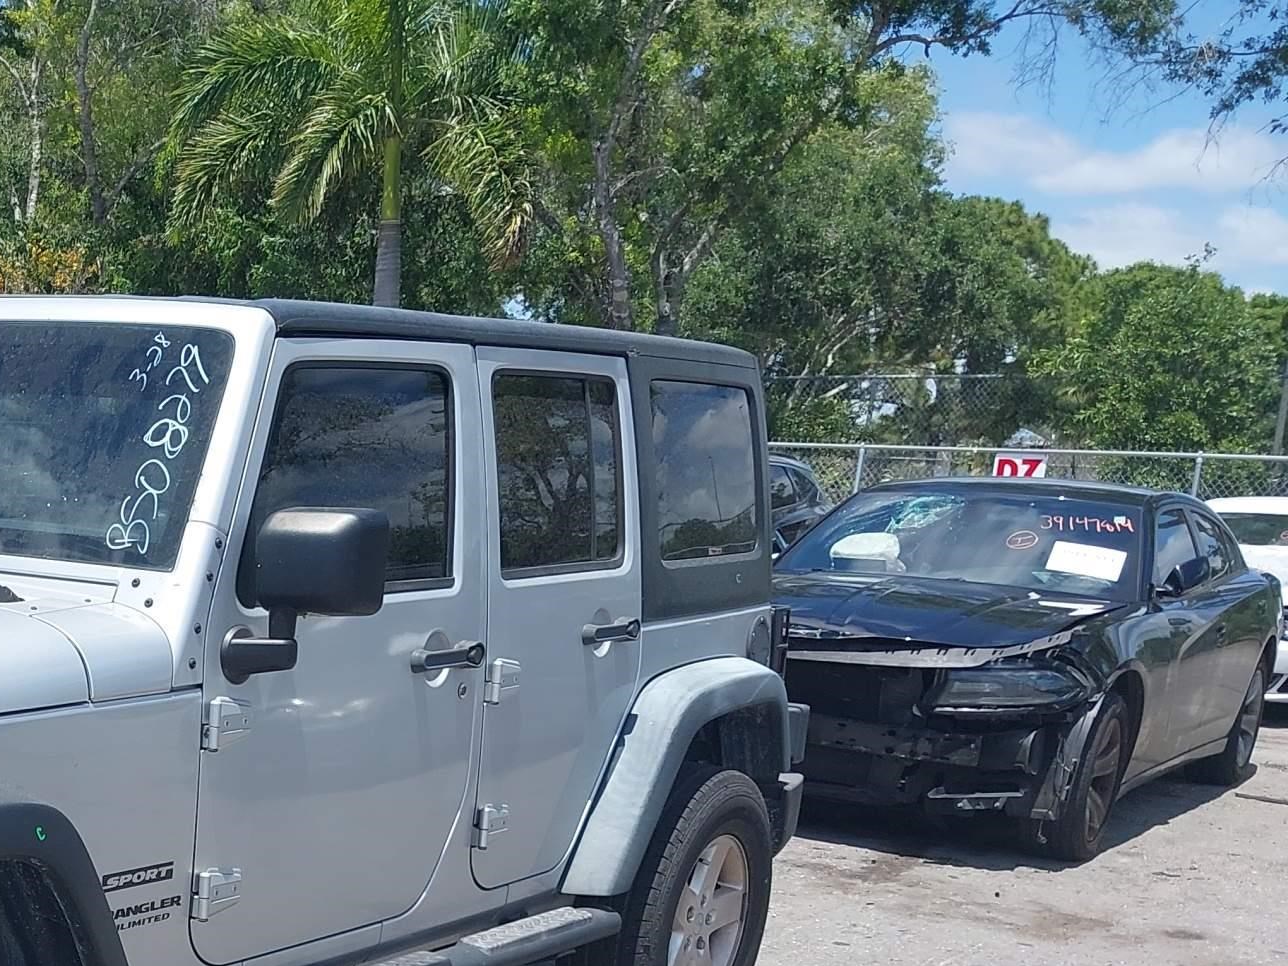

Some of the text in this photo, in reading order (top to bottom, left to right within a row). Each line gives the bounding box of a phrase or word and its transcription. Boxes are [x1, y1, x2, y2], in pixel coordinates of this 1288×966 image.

[129, 331, 171, 391] 3-28
[996, 459, 1043, 478] DZ
[104, 865, 173, 889] SPORT
